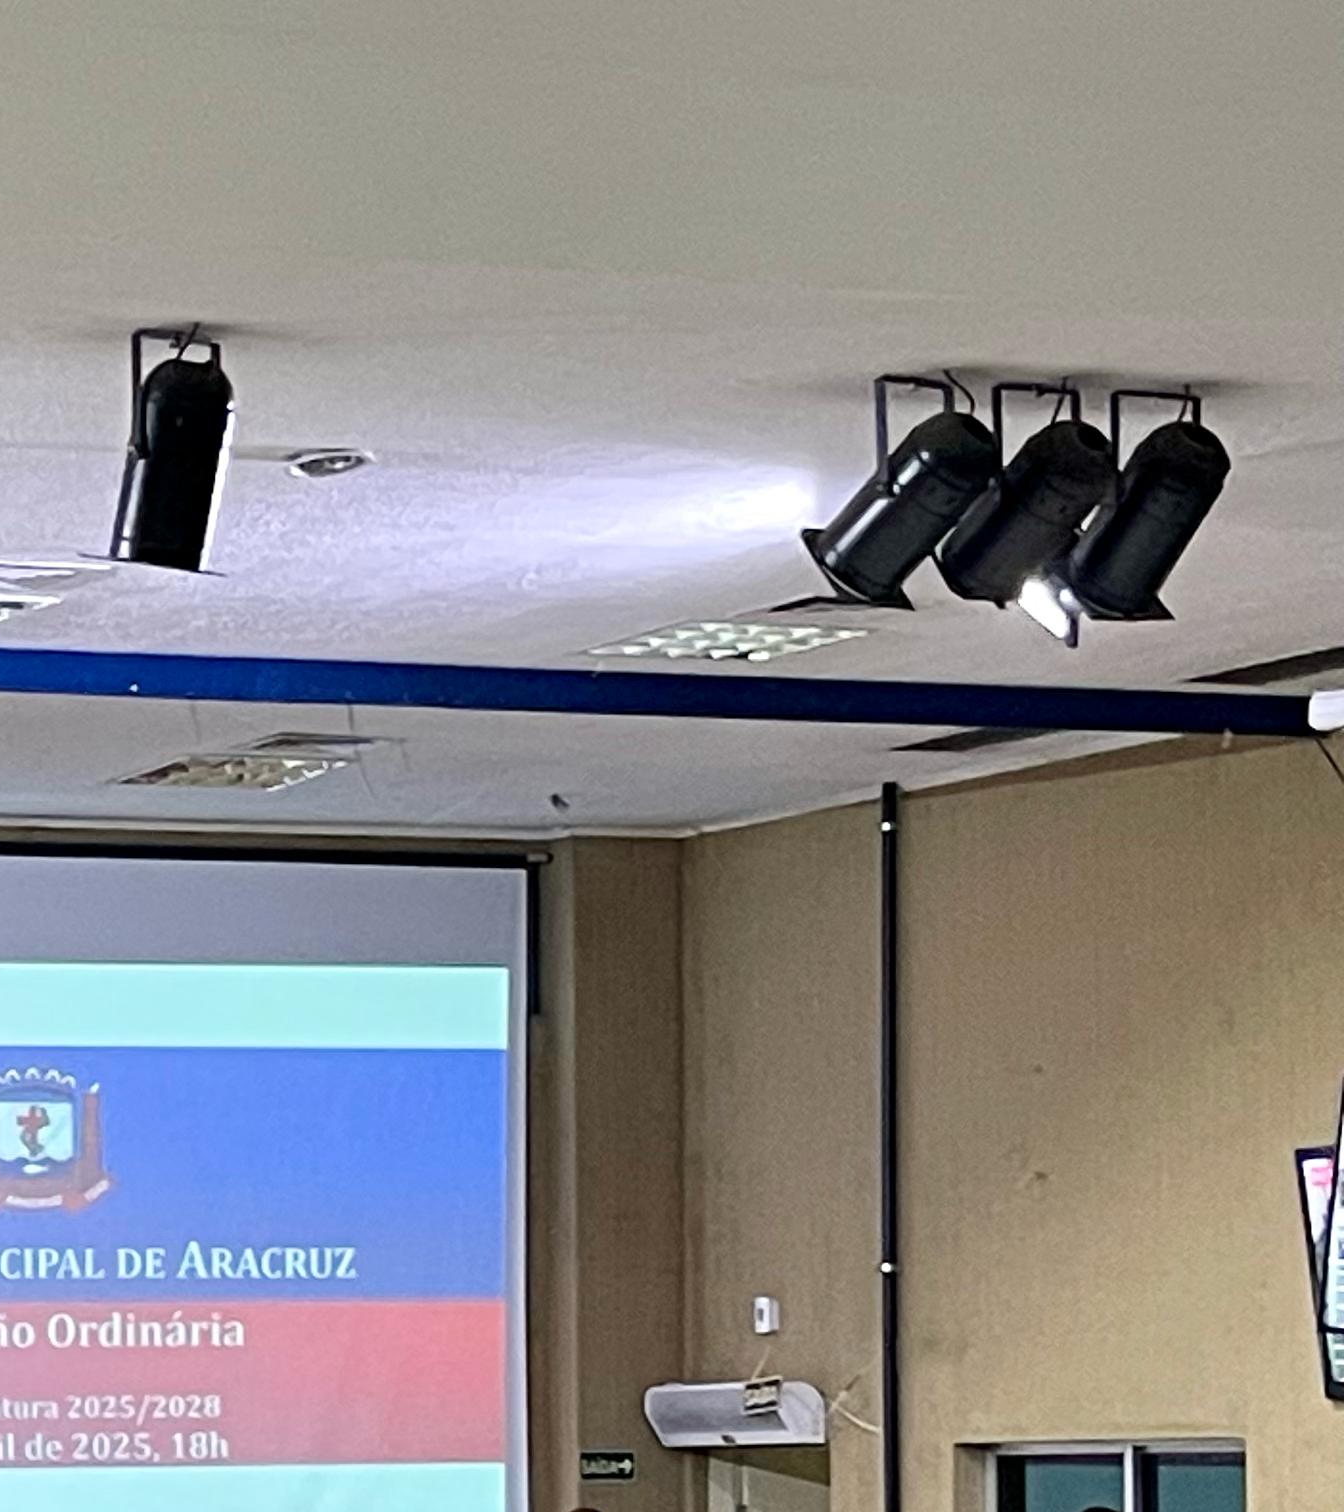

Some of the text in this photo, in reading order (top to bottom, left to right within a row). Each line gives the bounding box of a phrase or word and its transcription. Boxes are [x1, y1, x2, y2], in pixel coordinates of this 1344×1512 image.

[116, 1247, 166, 1280] DE
[176, 1240, 358, 1280] ARACRUZ
[47, 1311, 244, 1348] Ordinária
[66, 1394, 222, 1427] 2025/2028
[23, 1432, 63, 1462] de
[70, 1431, 161, 1463] 2025,
[172, 1431, 229, 1460] 18h
